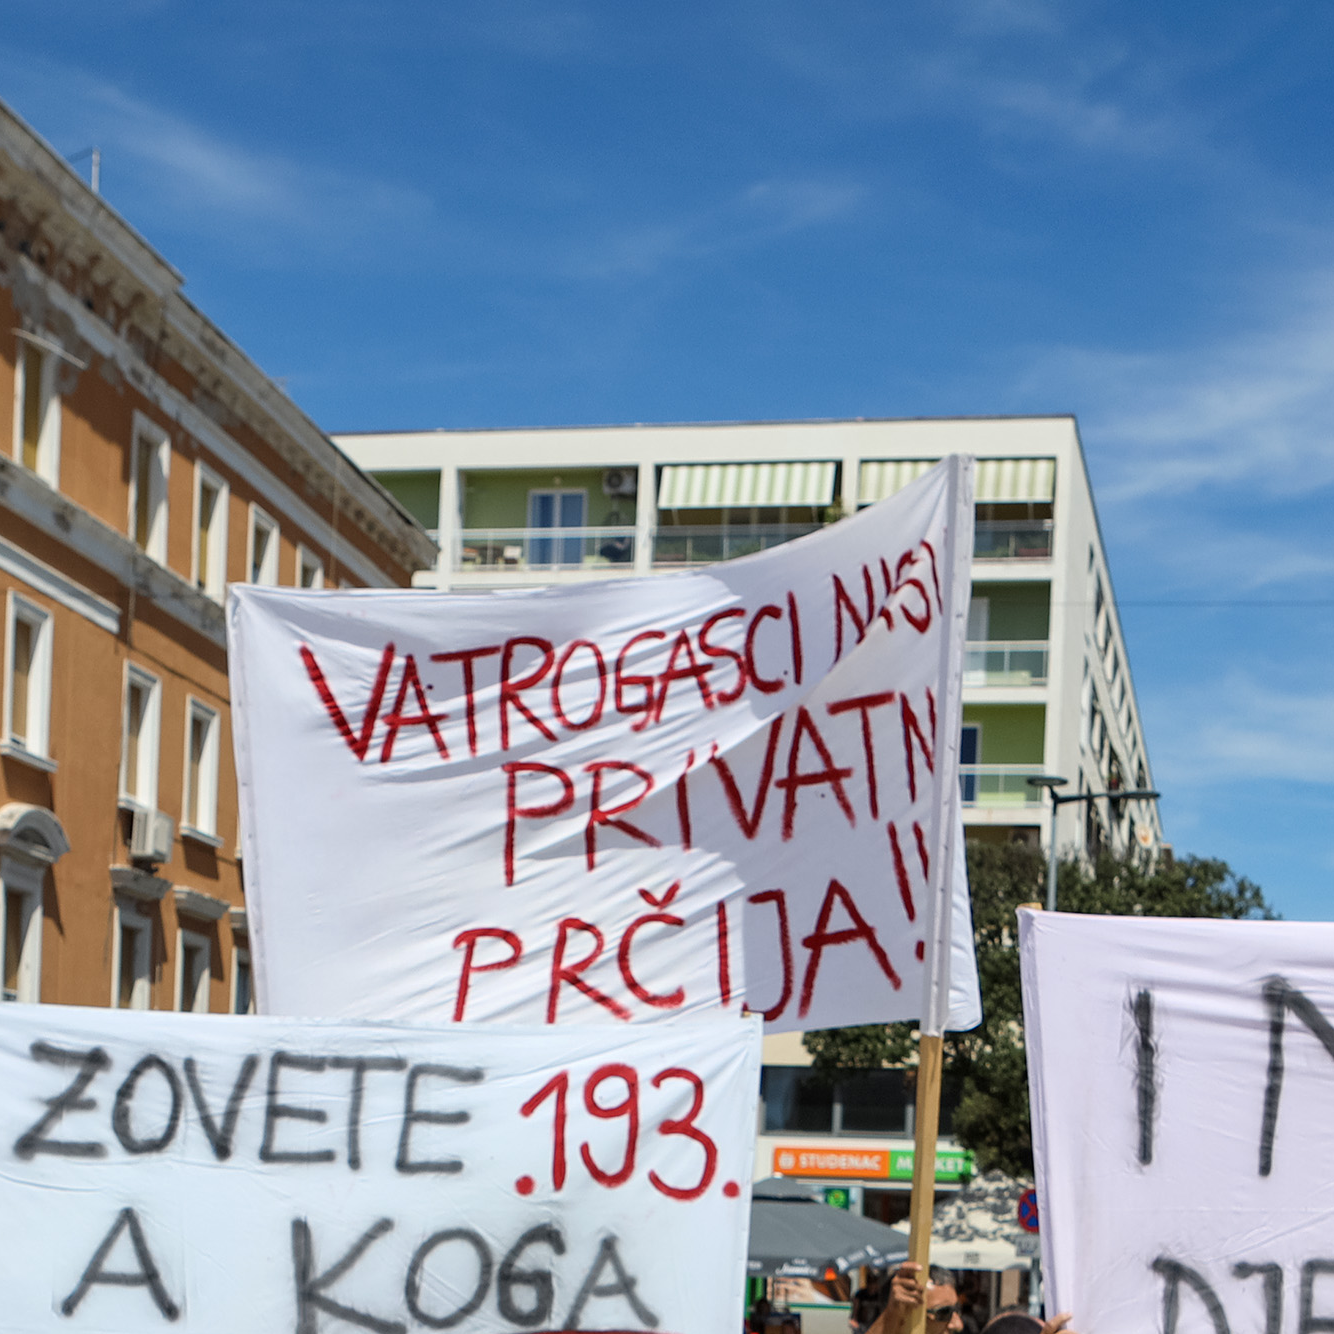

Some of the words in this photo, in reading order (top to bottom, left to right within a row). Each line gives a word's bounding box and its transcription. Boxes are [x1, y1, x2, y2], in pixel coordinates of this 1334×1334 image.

[299, 590, 802, 763] VATROGASCI
[13, 1040, 486, 1174] ZOVETE
[1130, 984, 1160, 1166] I
[799, 1154, 882, 1171] STUDENAC
[896, 1155, 966, 1172] MKET
[60, 1207, 181, 1322] A
